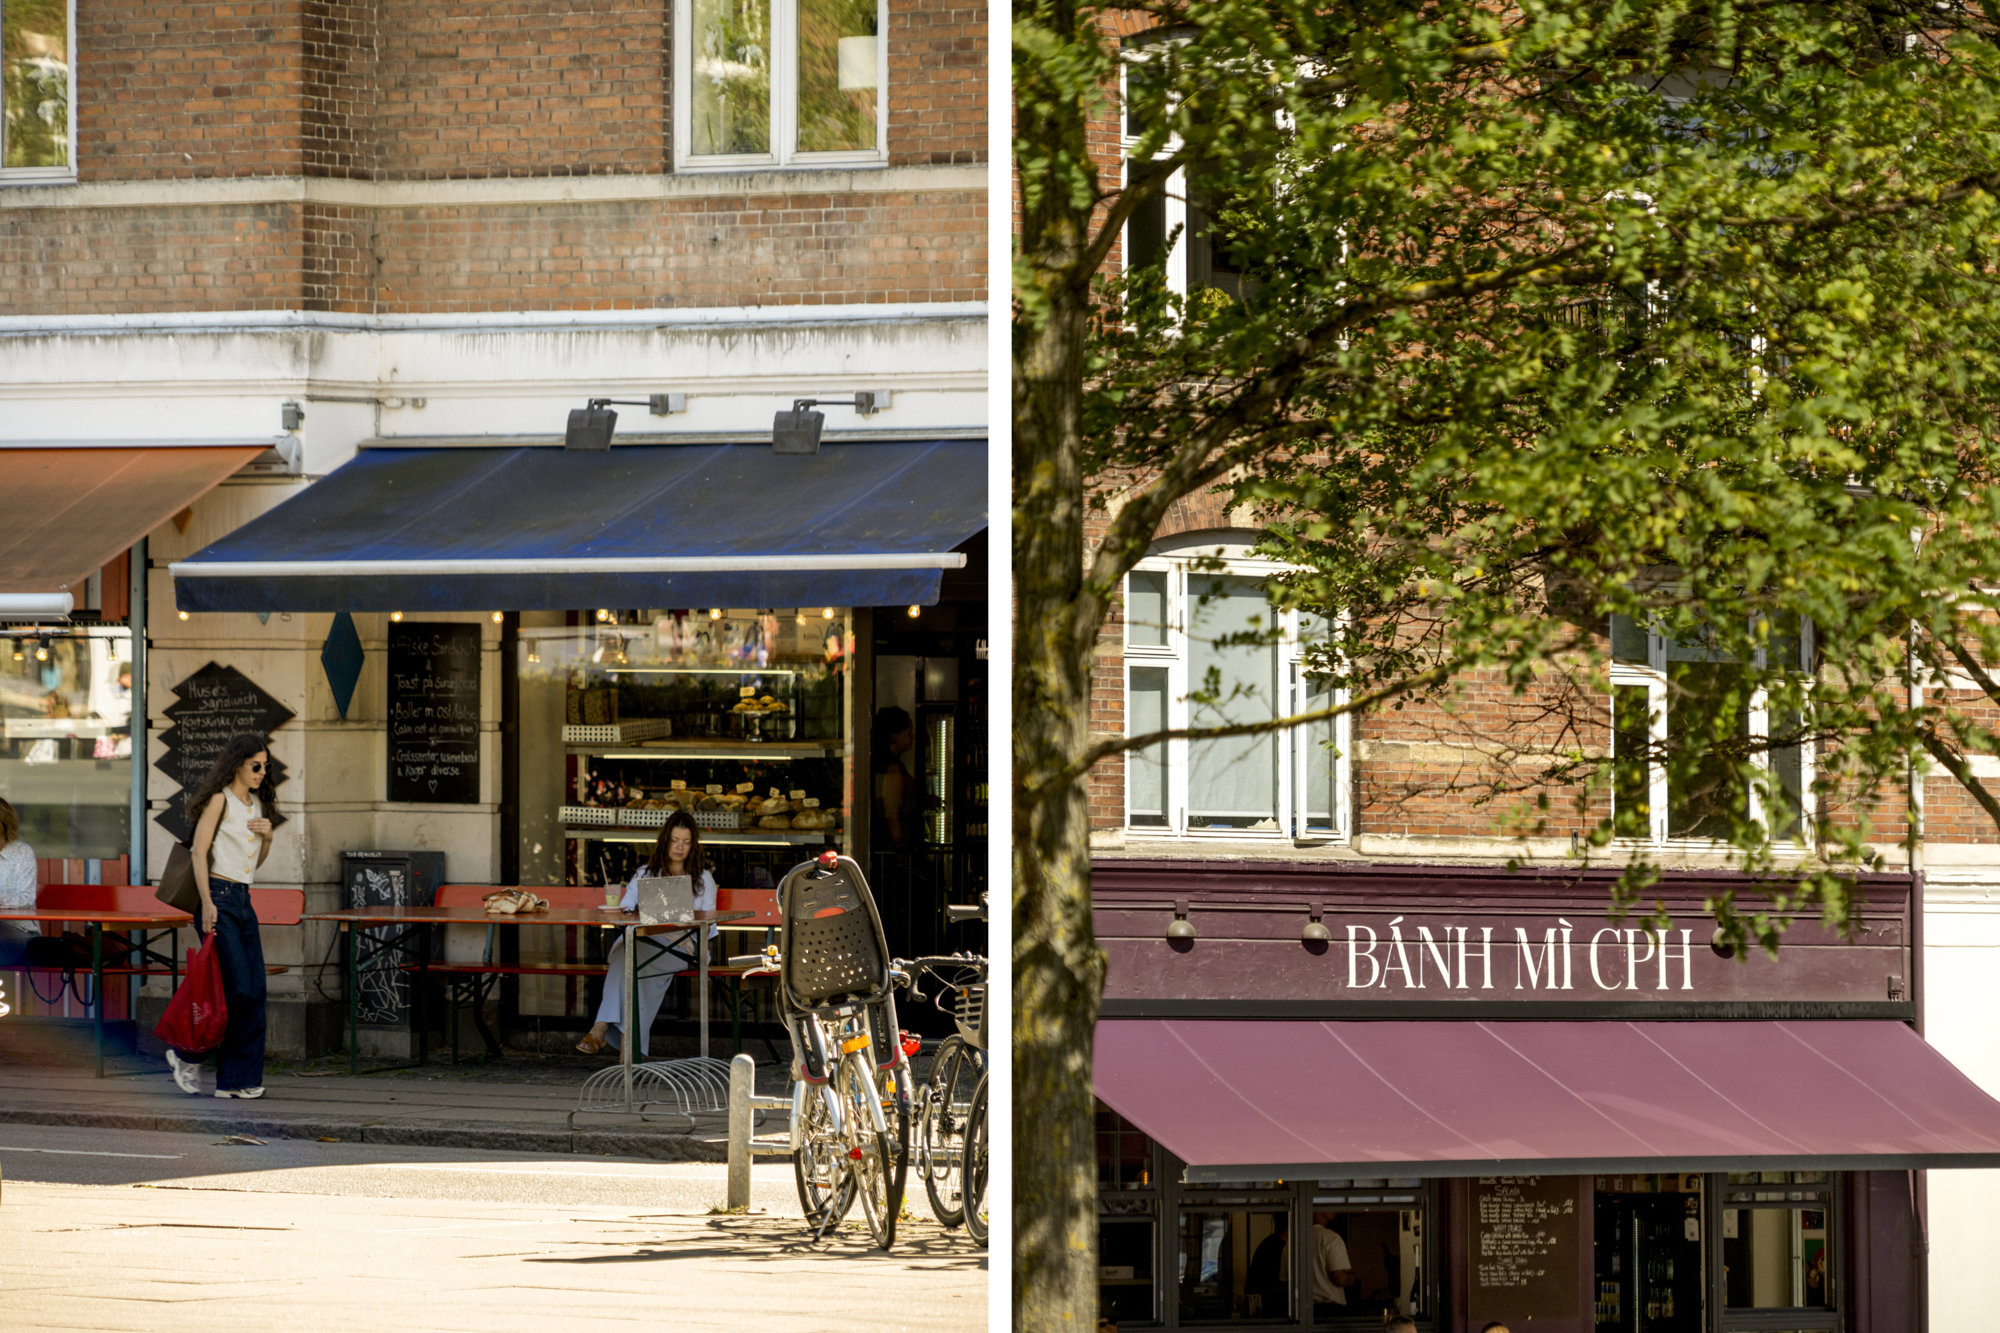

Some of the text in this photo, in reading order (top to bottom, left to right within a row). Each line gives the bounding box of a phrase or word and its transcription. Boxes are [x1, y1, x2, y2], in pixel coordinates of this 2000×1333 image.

[1345, 915, 1694, 990] BÁNH MÌ CPH
